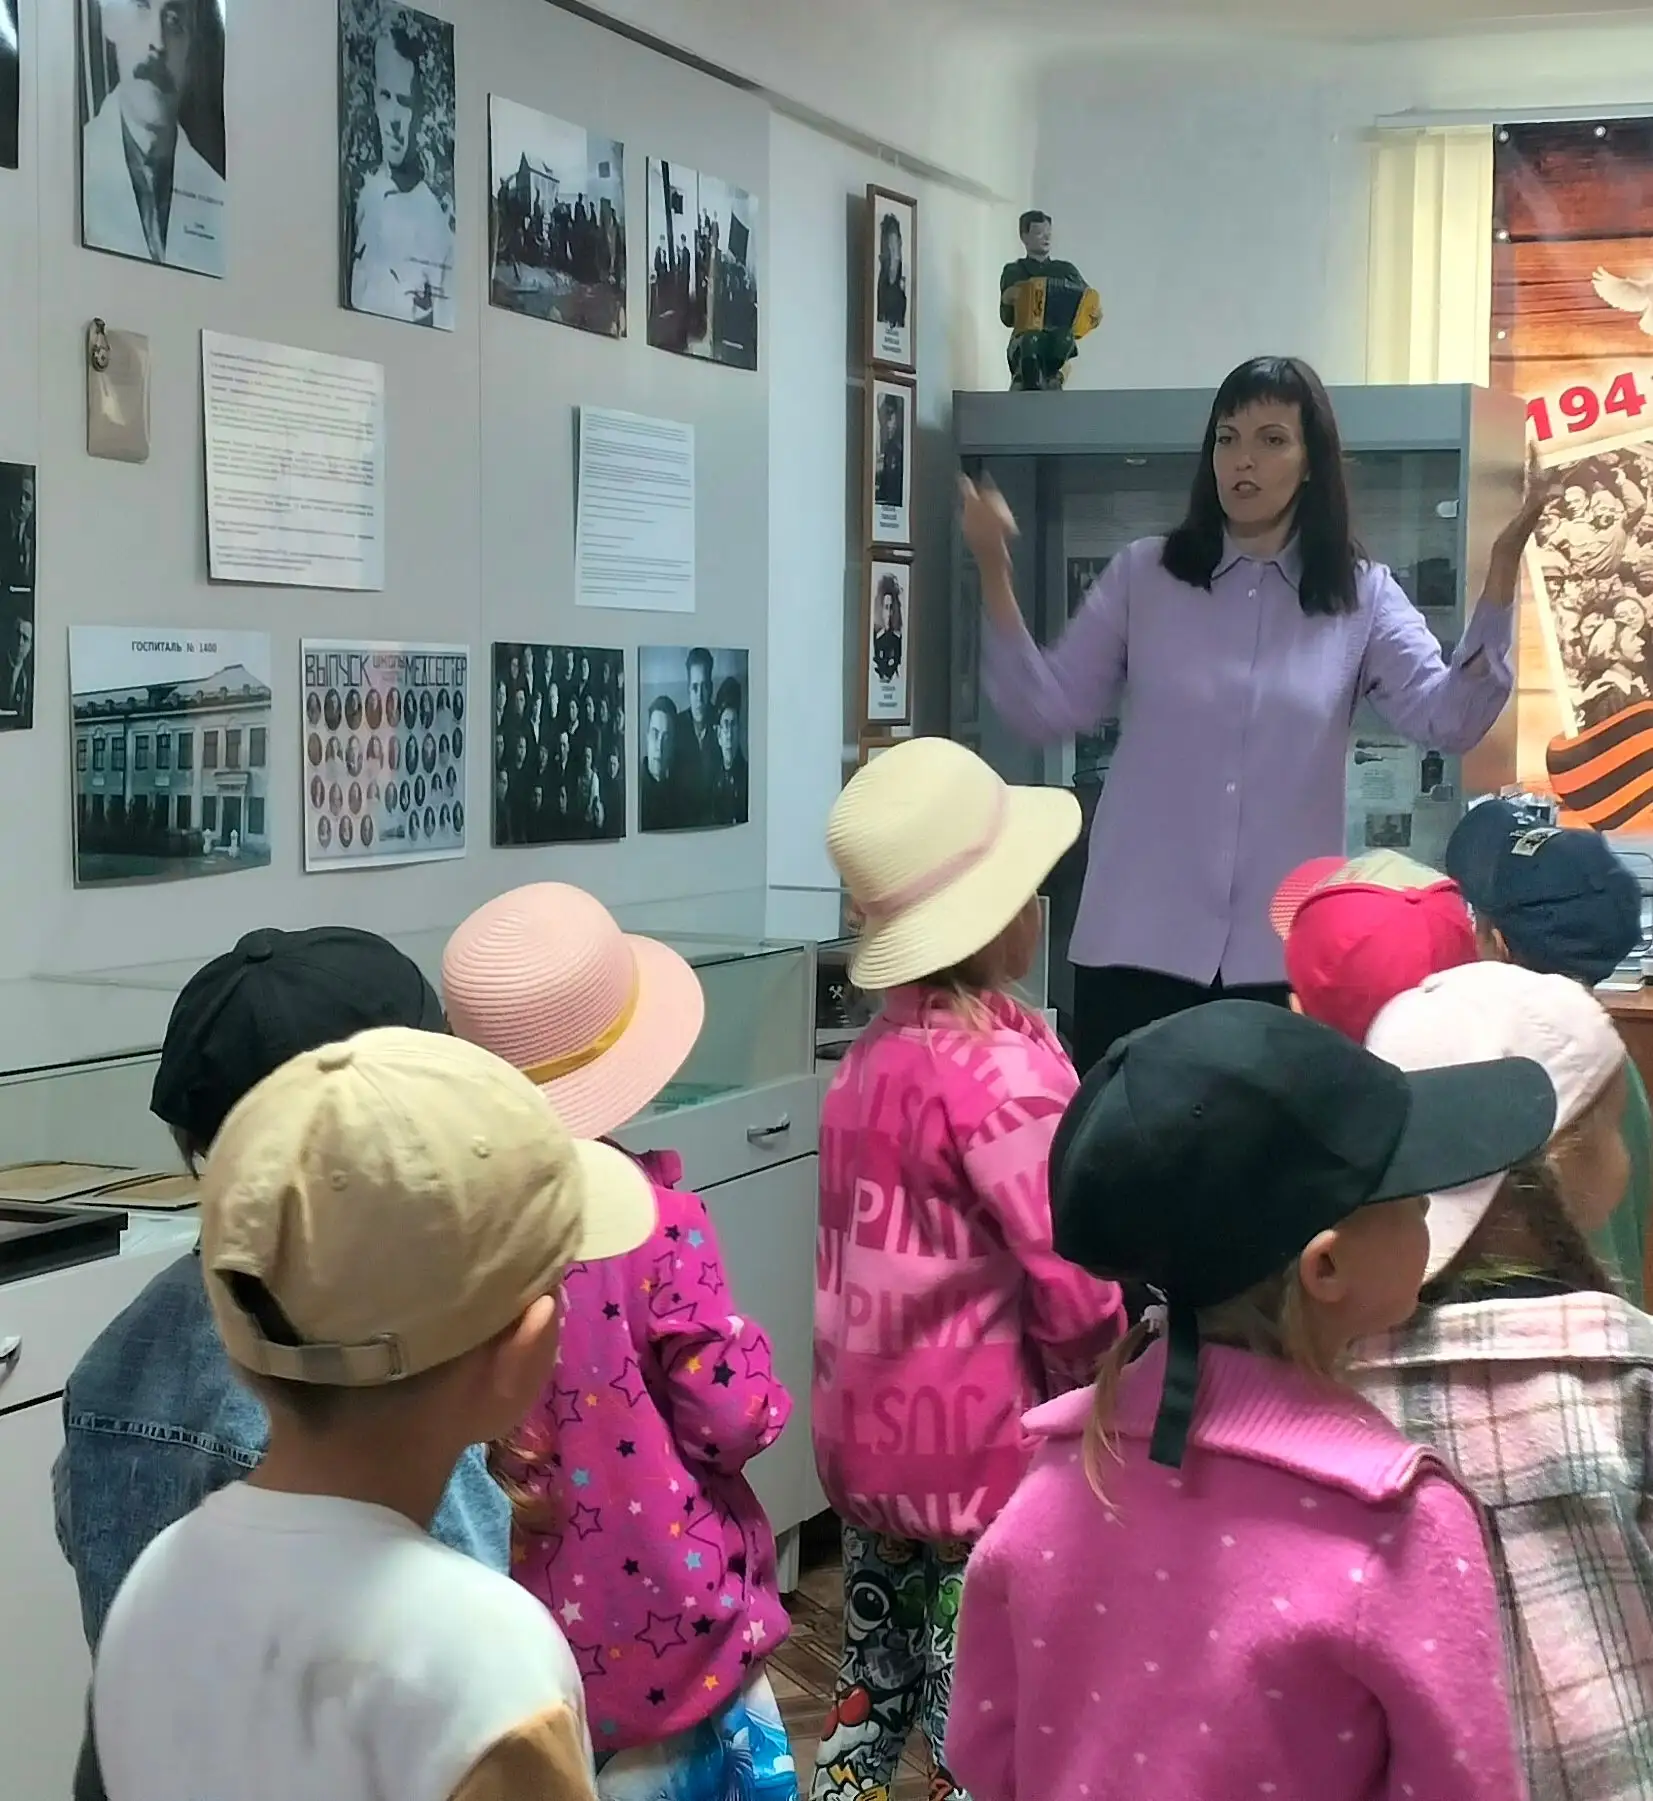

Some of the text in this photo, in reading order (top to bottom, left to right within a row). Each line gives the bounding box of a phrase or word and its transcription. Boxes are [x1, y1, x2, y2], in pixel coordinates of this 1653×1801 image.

[1526, 371, 1653, 442] 194
[131, 641, 218, 653] ГОСПИТАЛЬ № 1400
[305, 654, 373, 687] ВЫПУСК
[850, 1486, 990, 1537] PINK
